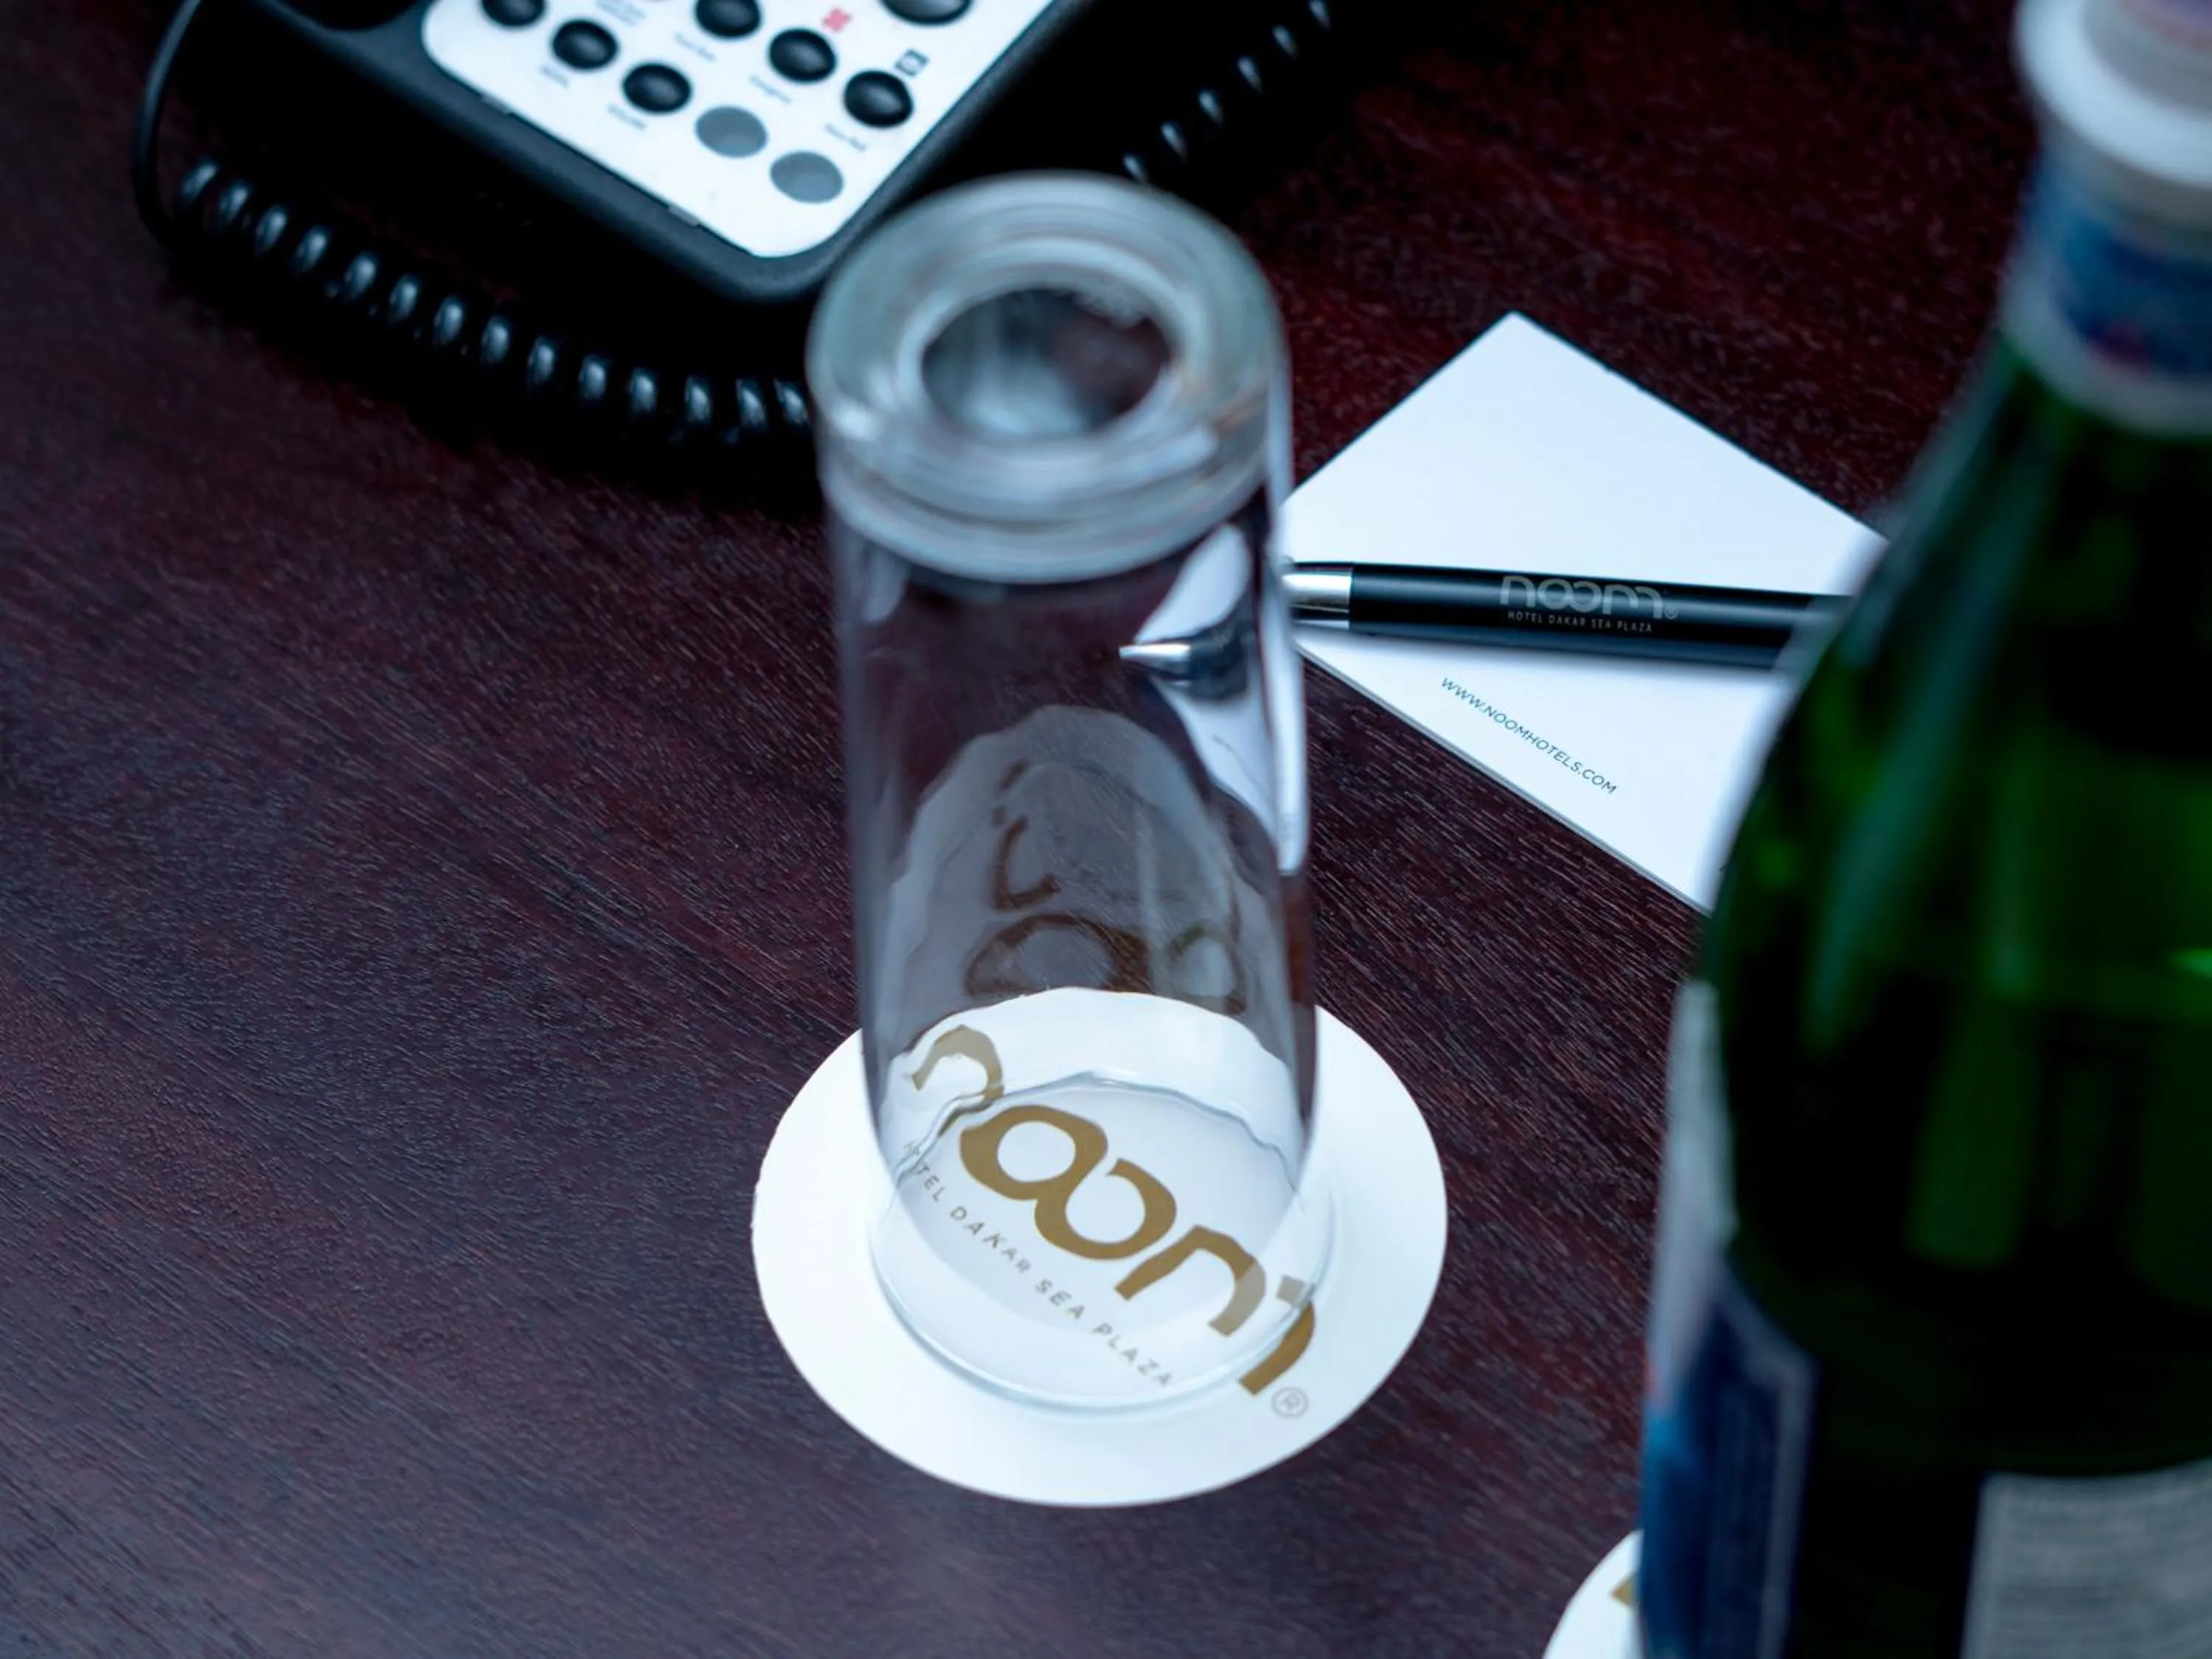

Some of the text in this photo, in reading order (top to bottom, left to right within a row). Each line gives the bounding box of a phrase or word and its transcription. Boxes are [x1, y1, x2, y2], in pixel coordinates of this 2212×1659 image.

[1508, 611, 1653, 633] HOTEL DAKAR SEA PLAZA
[1441, 677, 1618, 794] WWW.NOOMHOTELS.COM
[950, 1206, 1032, 1275] DAKAR
[1034, 1279, 1085, 1320] SEA
[1091, 1322, 1173, 1388] PLAZA
